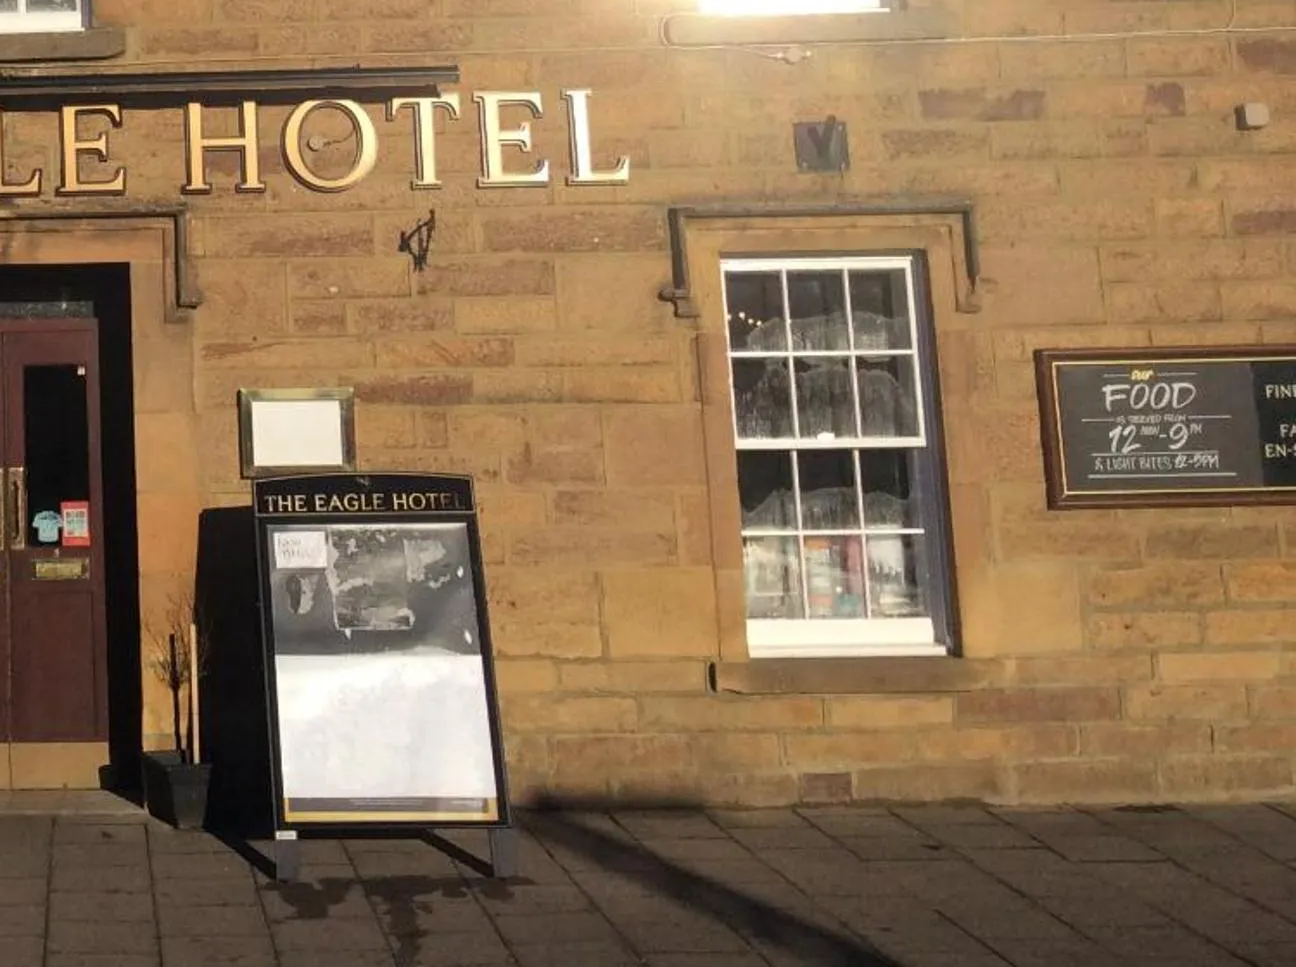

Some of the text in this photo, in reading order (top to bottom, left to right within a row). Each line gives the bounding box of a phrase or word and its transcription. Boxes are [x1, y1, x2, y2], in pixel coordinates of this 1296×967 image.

[180, 88, 631, 193] HOTEL
[1101, 382, 1197, 411] FOOD
[1106, 456, 1136, 470] LIGHT
[1138, 455, 1172, 470] BITES
[264, 491, 466, 512] THE EAGLE HOTEL
